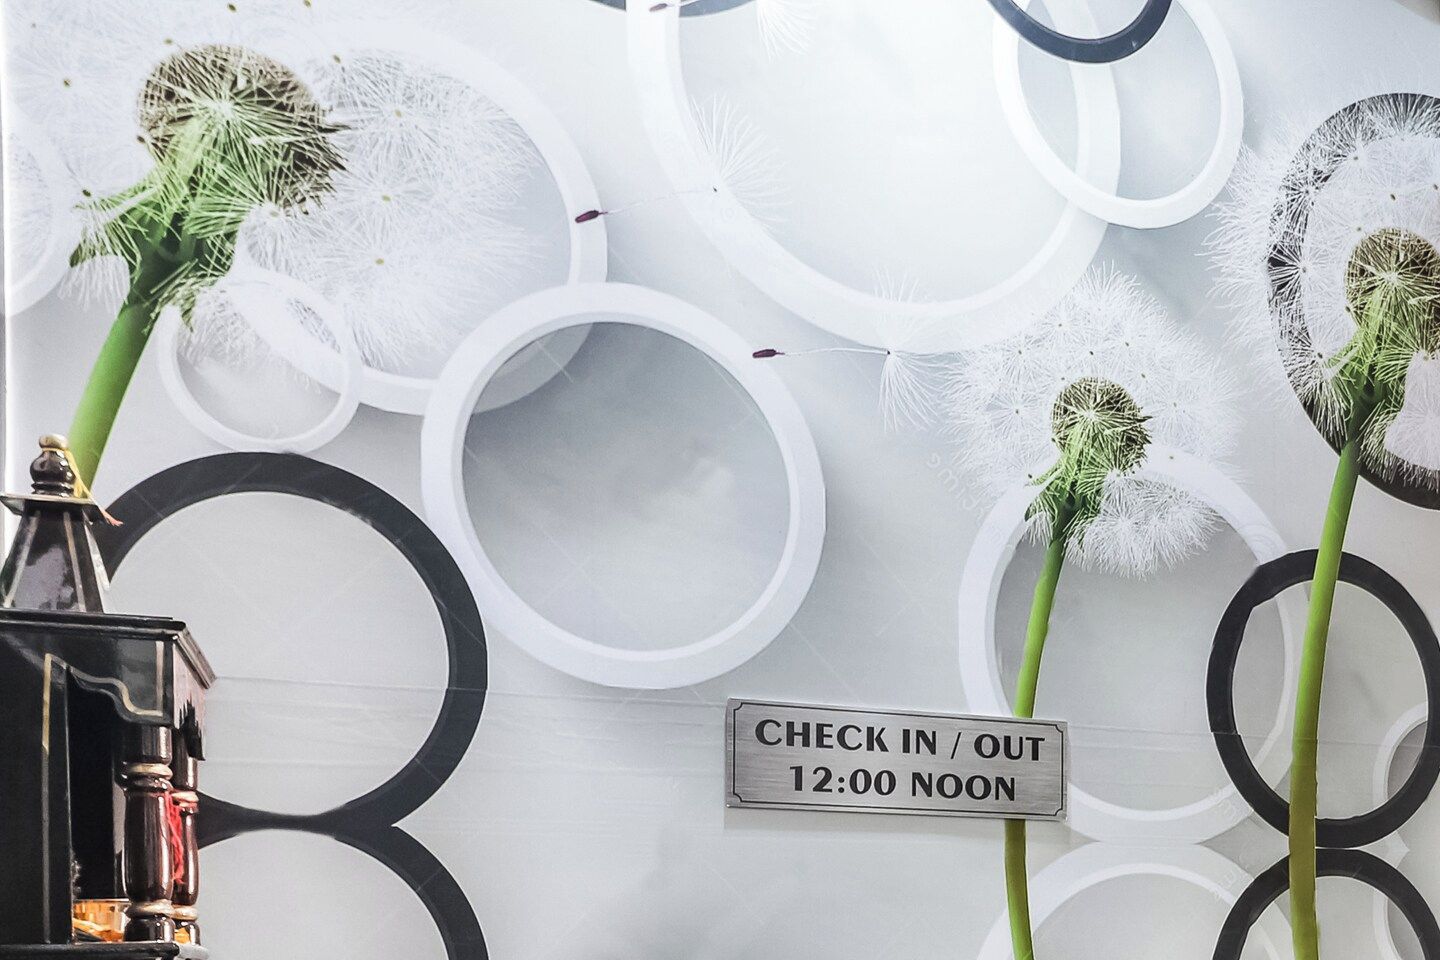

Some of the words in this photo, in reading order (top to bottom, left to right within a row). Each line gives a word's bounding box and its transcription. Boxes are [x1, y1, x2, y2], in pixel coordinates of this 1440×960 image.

[754, 719, 889, 753] CHECK
[902, 728, 937, 755] IN
[950, 732, 962, 760] /
[973, 733, 1046, 761] OUT
[789, 765, 897, 795] 12:00
[911, 772, 1016, 801] NOON
